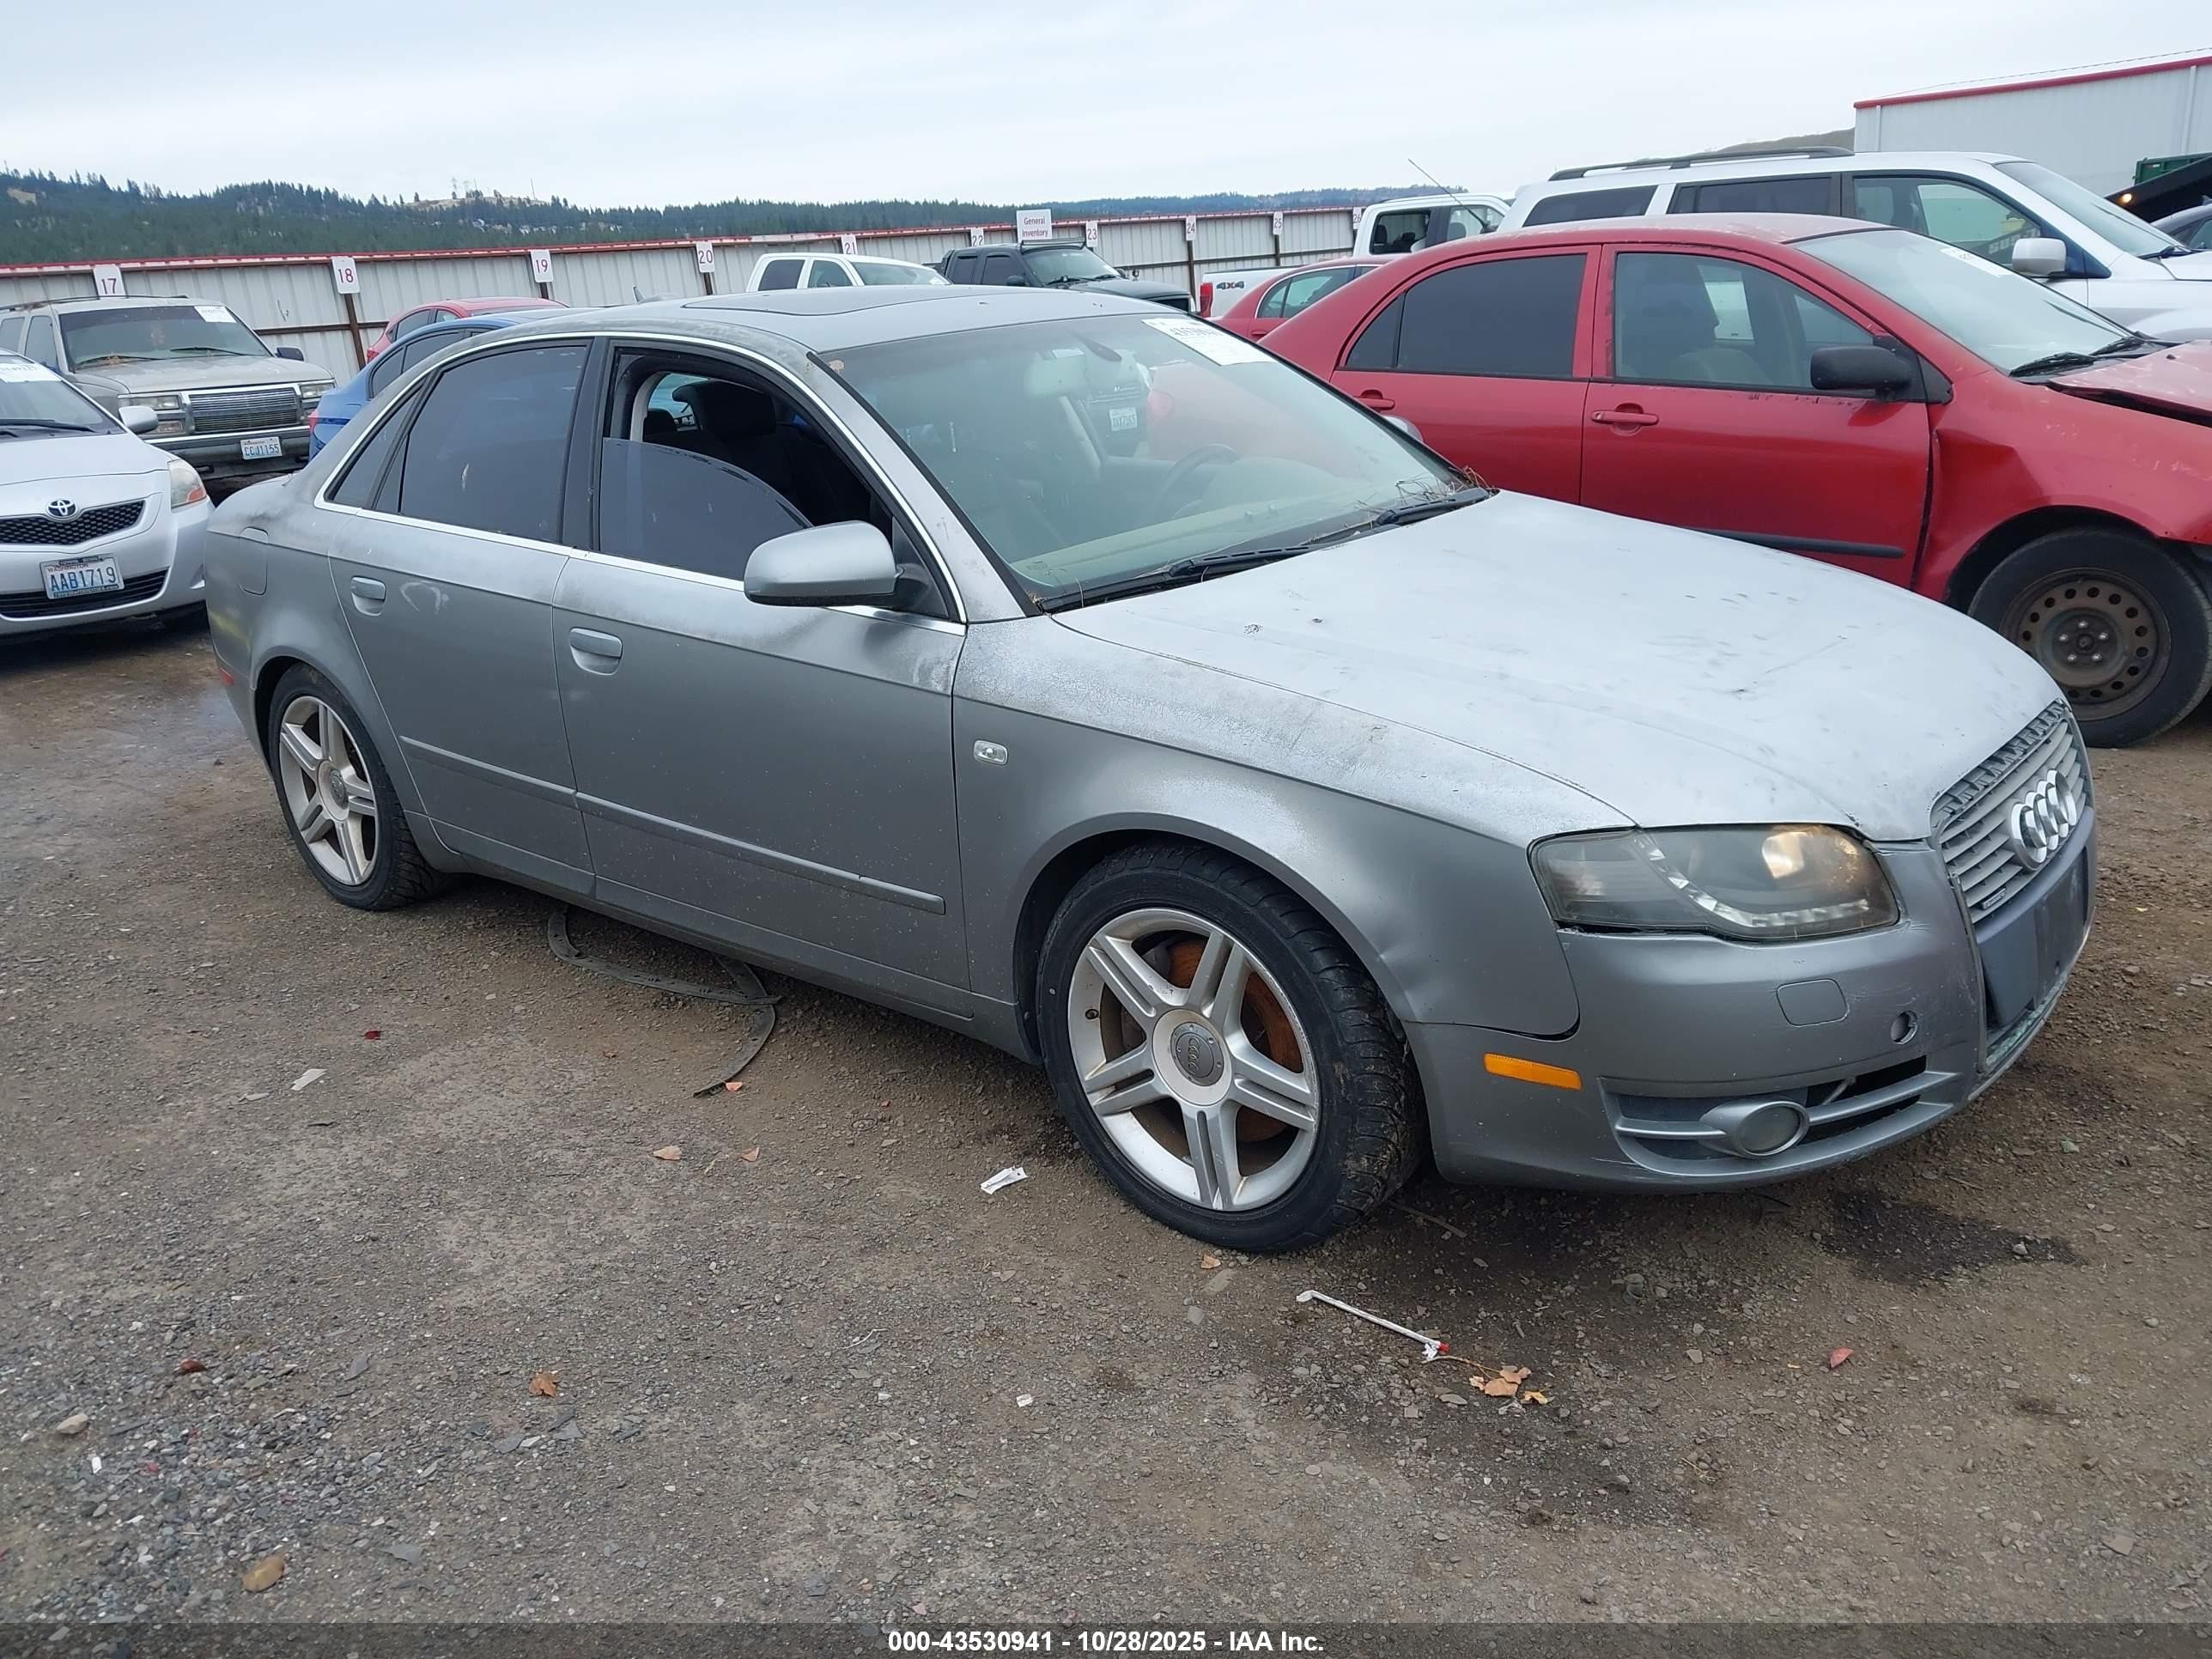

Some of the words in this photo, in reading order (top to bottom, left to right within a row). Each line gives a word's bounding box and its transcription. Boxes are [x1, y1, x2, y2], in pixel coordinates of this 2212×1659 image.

[1024, 216, 1045, 225] General
[1274, 218, 1282, 228] 25
[1087, 228, 1097, 240] 23
[1187, 222, 1195, 234] 24
[972, 234, 983, 246] 22
[844, 242, 856, 254] 21
[698, 249, 714, 264] 20
[536, 258, 548, 274] 19
[338, 268, 354, 283] 18
[100, 277, 117, 295] 17
[50, 566, 117, 592] AAB1719
